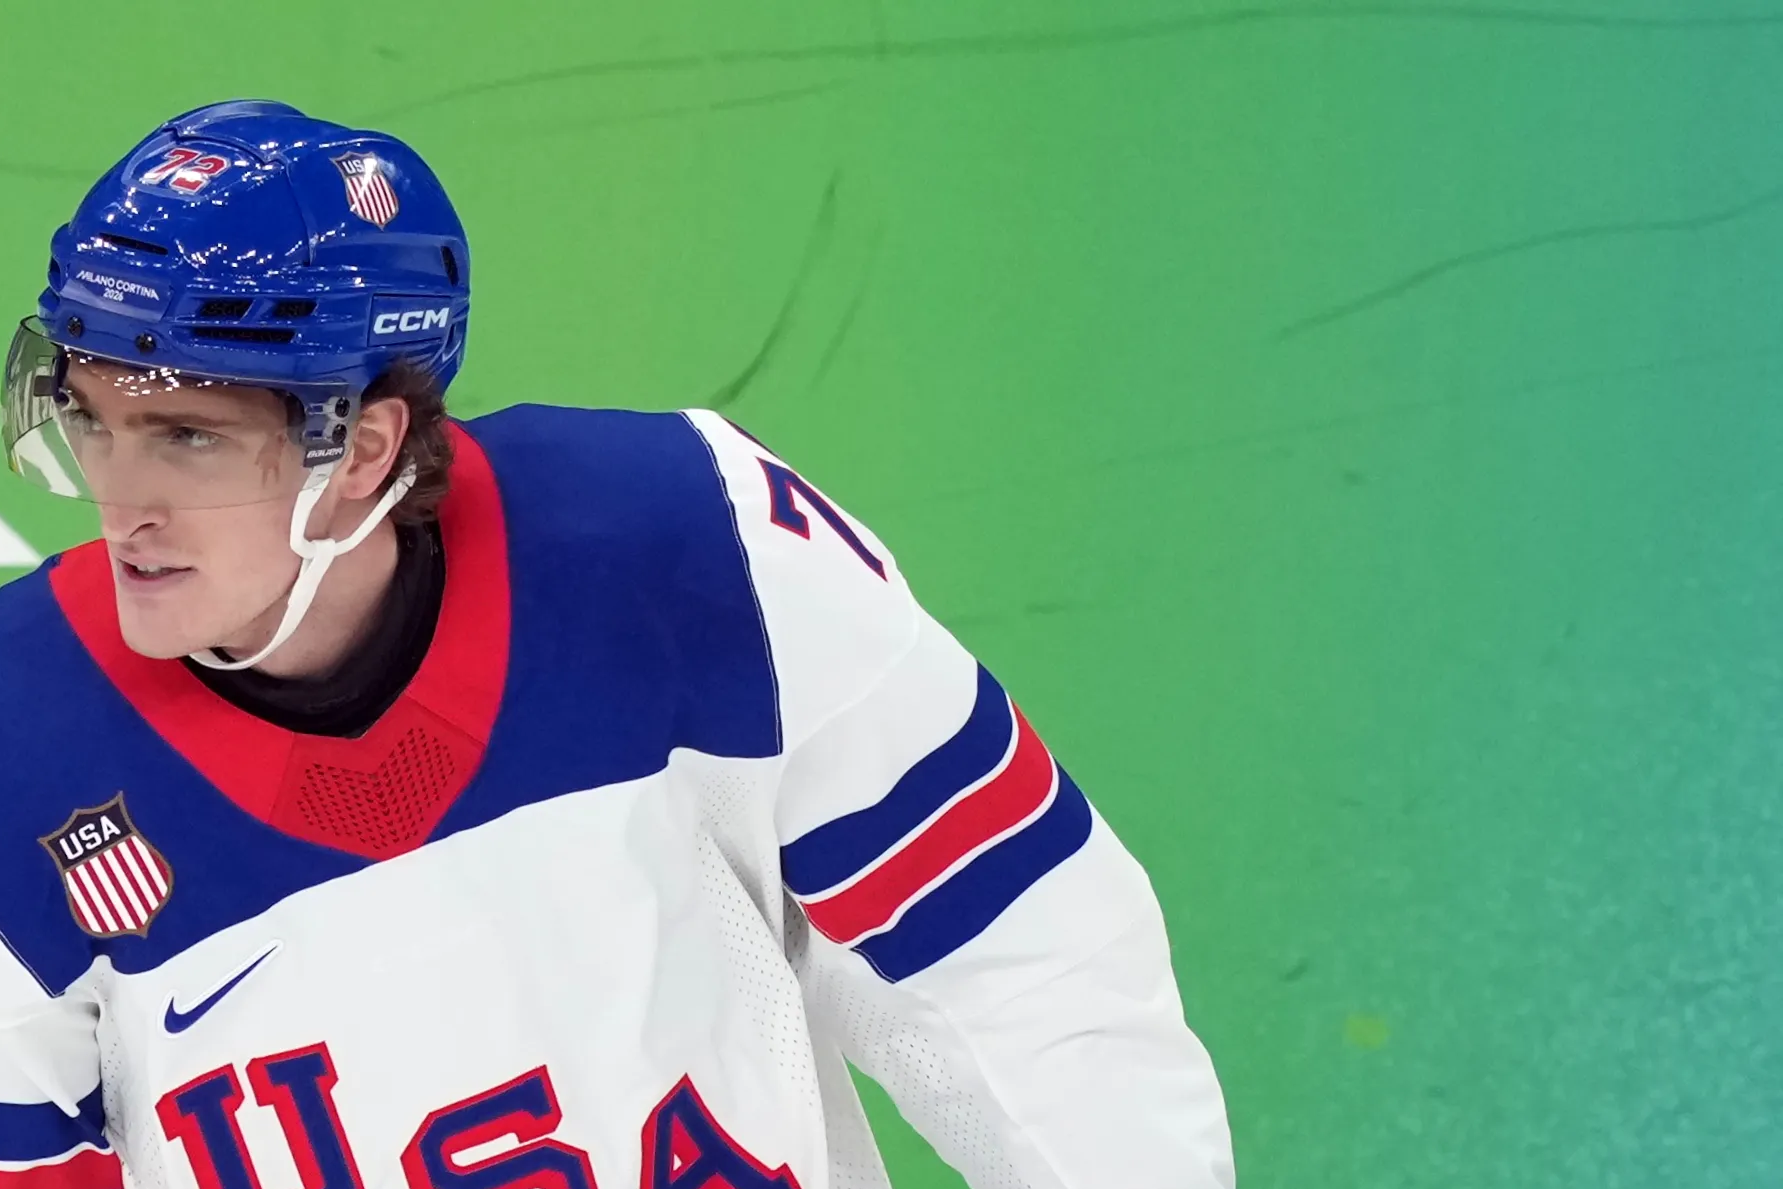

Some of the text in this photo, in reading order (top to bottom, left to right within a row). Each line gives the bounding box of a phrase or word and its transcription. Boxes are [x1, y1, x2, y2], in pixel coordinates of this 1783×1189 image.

[139, 148, 230, 195] 72
[341, 158, 377, 175] US
[75, 269, 160, 301] MILANO CORTINA
[103, 287, 124, 302] 2026
[373, 307, 450, 335] CCM
[721, 415, 889, 583] 7
[59, 814, 121, 861] USA
